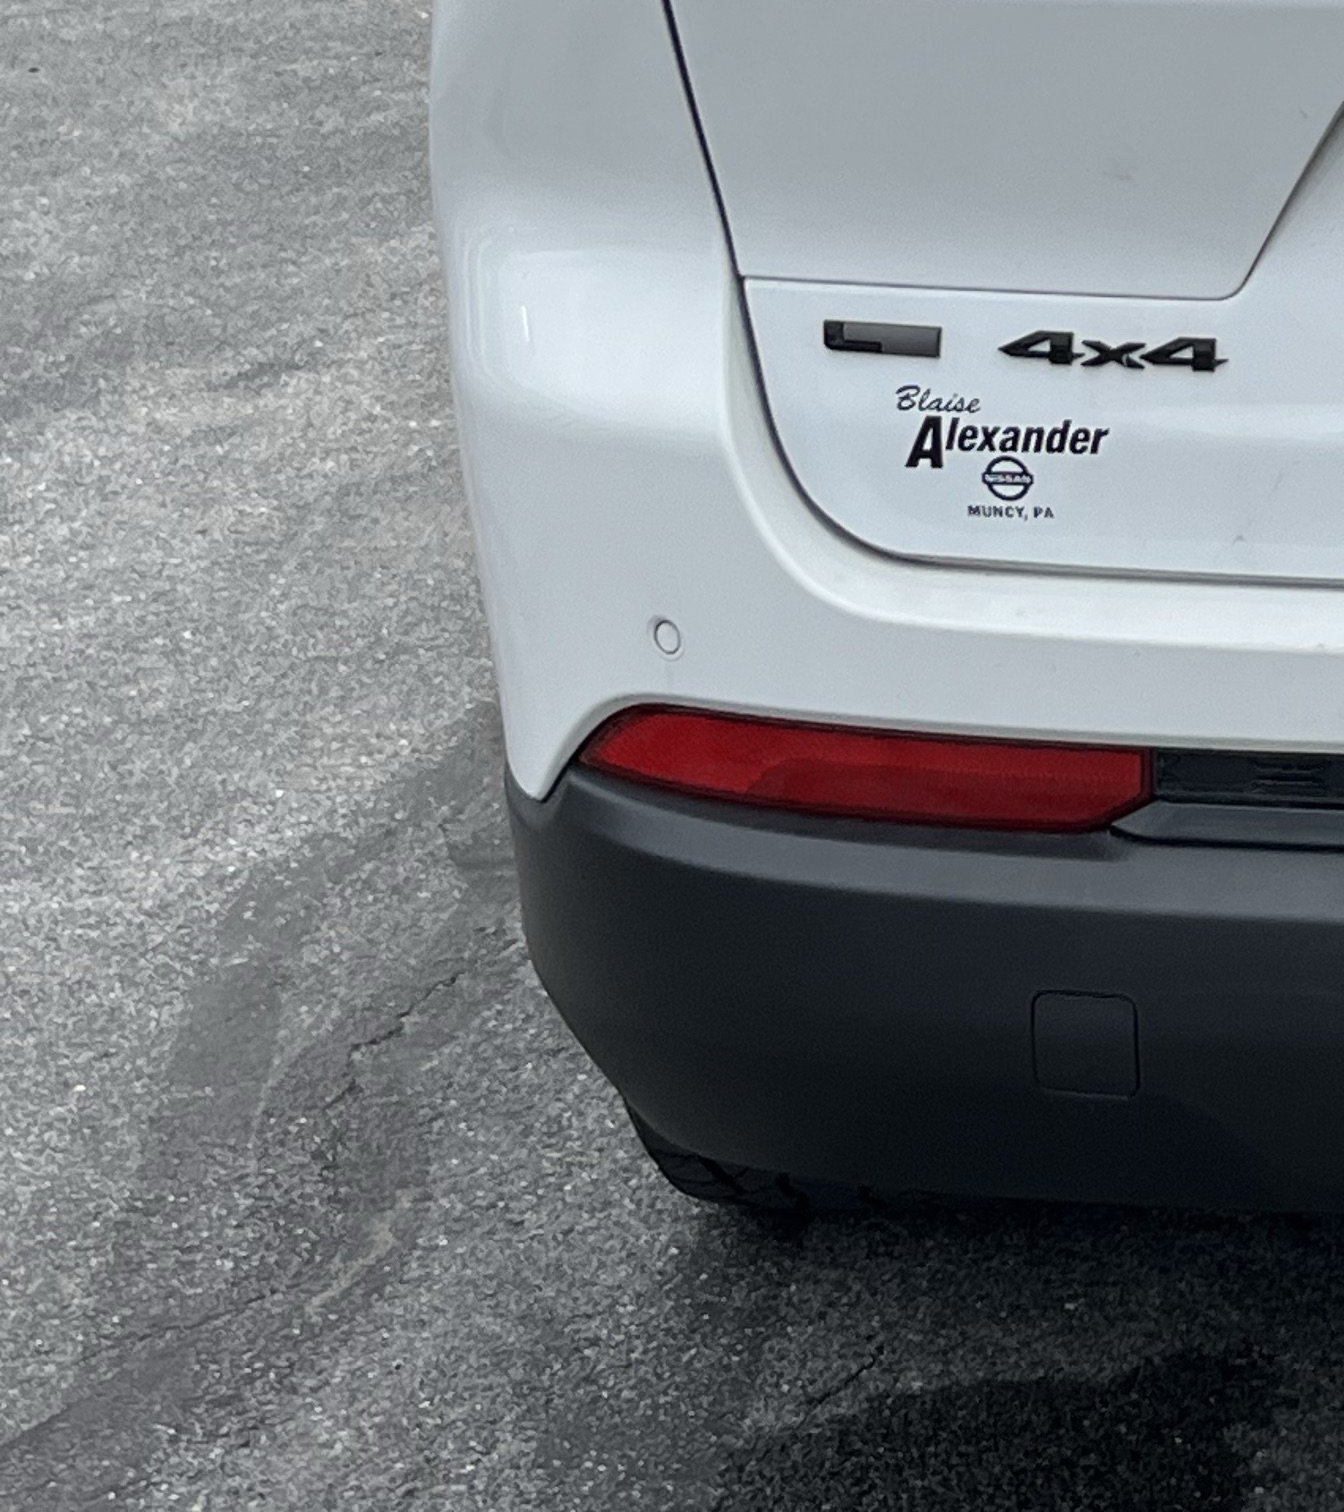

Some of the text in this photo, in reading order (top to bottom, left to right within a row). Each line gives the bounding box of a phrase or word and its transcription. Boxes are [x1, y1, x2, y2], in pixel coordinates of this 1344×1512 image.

[998, 330, 1229, 372] 4x4
[895, 385, 981, 413] Blaise
[905, 415, 1110, 469] Alexander
[968, 505, 1054, 521] MUNCY, PA
